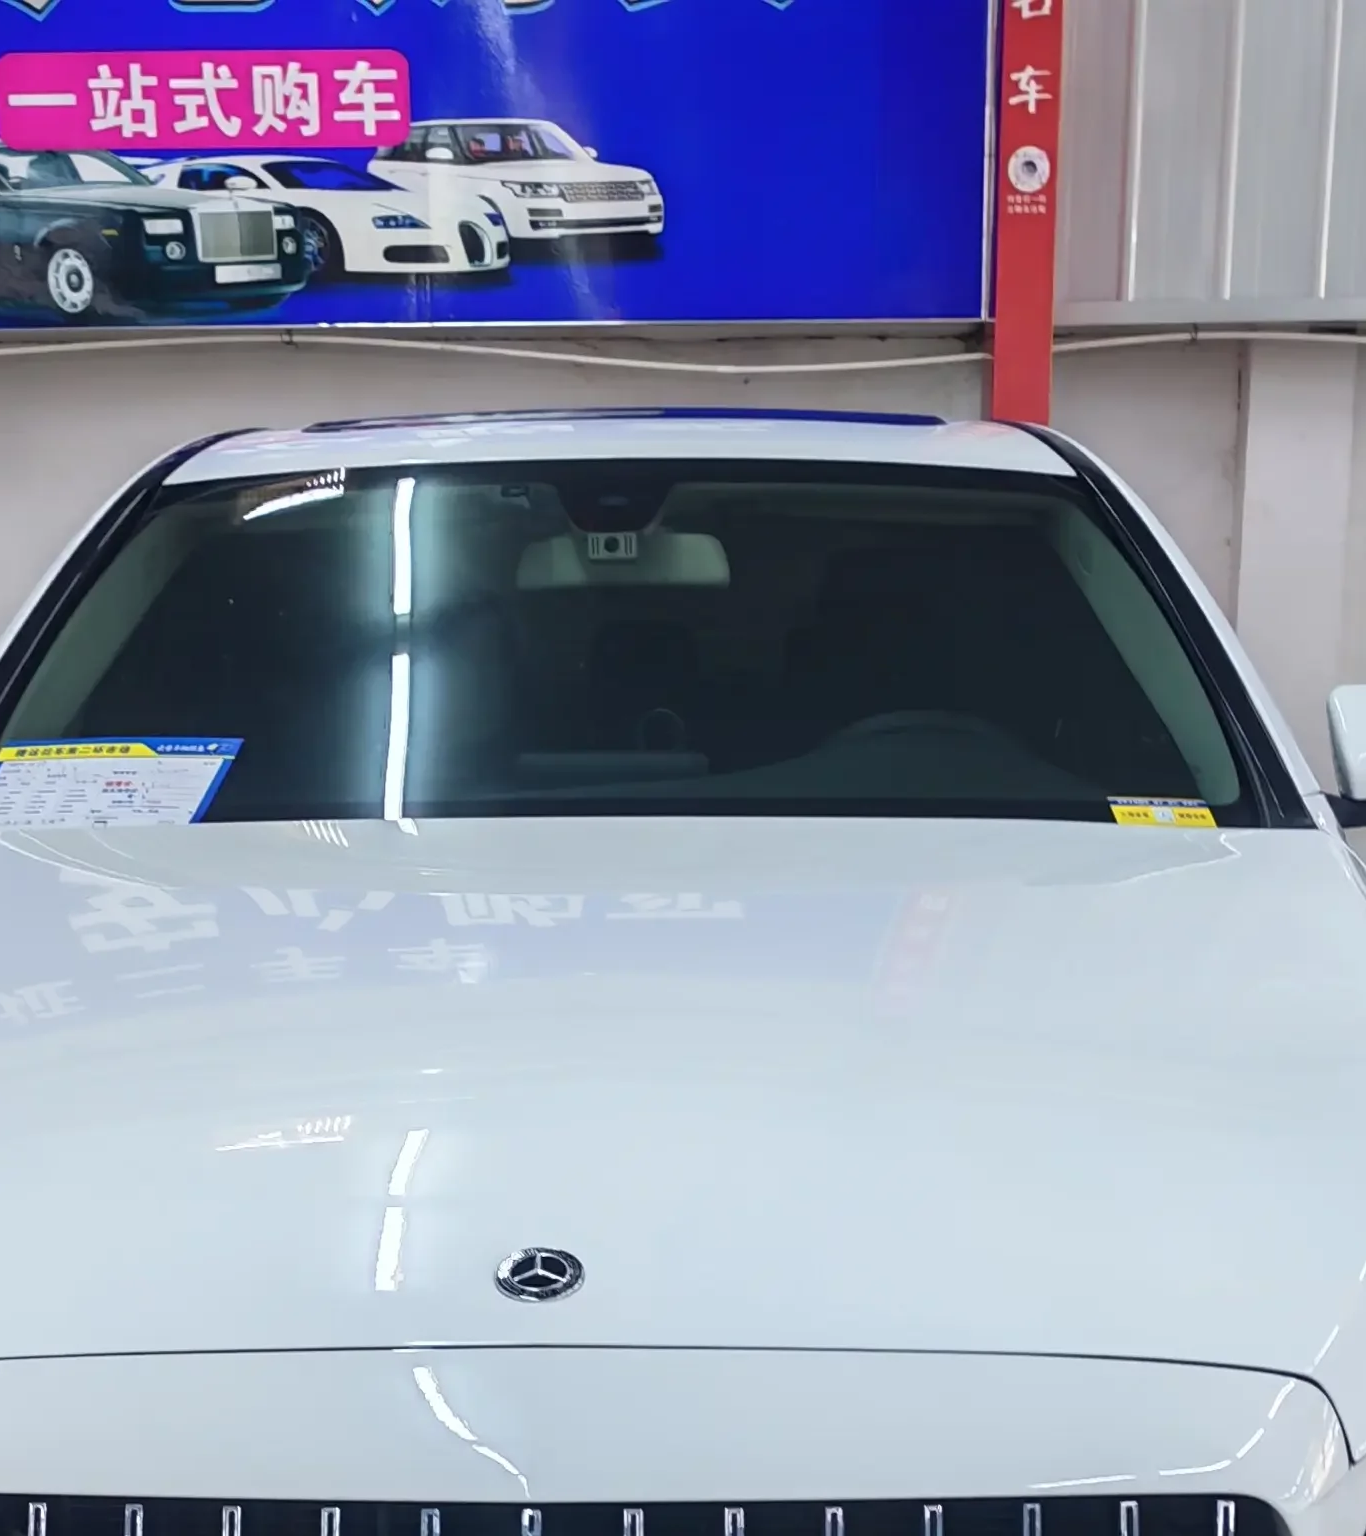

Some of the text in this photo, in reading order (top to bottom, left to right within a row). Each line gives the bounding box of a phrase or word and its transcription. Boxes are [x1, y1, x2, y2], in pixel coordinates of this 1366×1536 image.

[8, 61, 402, 138] 一站式购车
